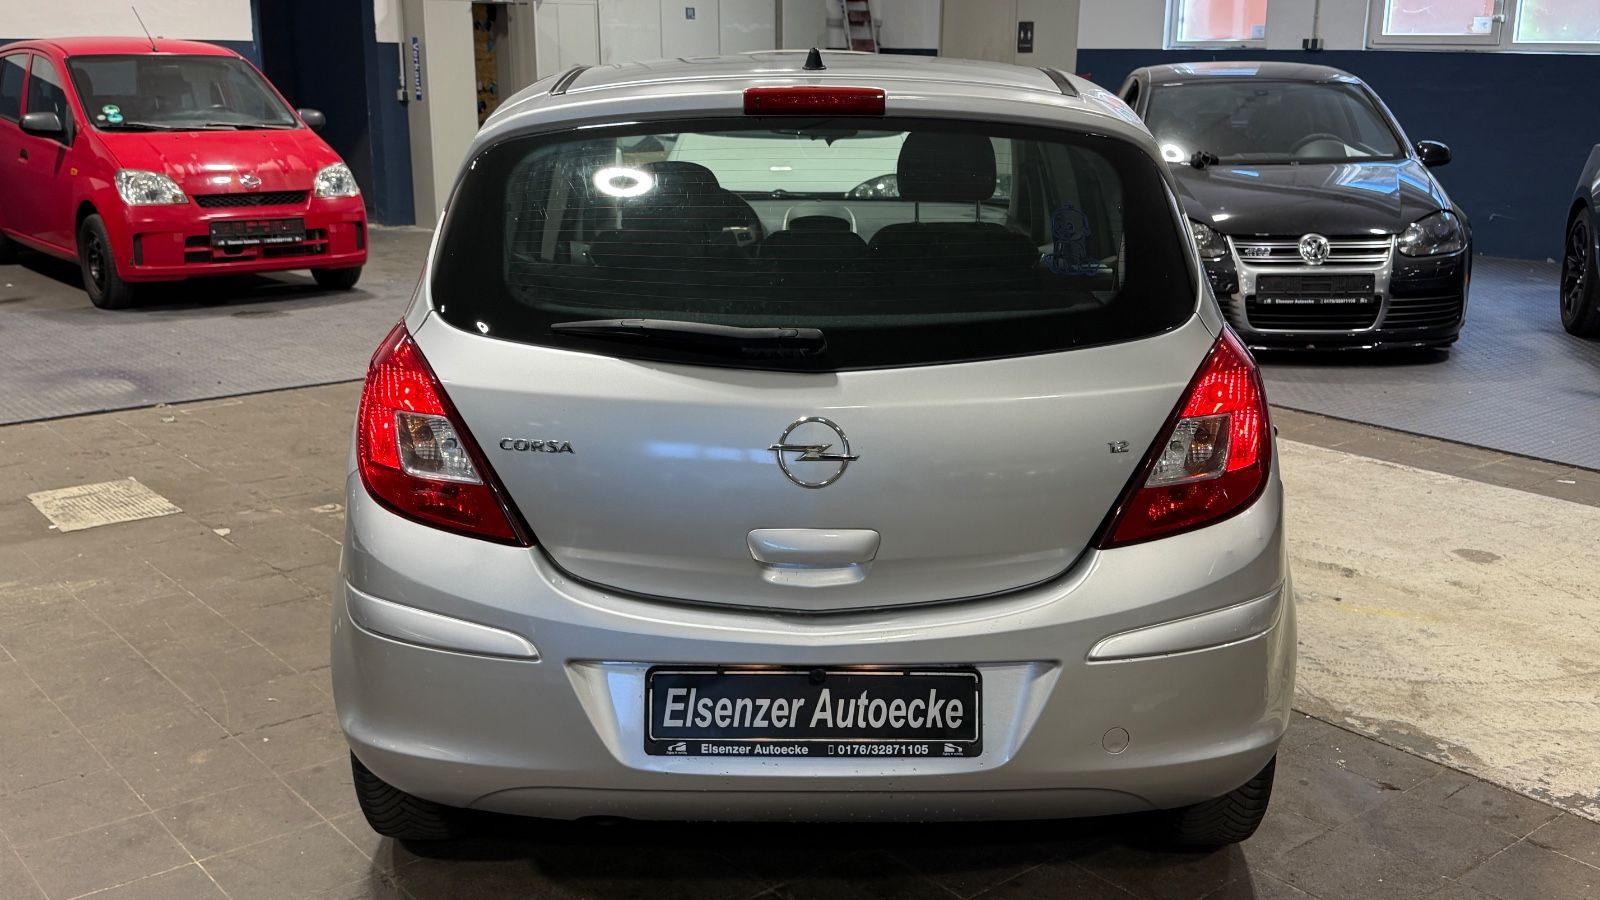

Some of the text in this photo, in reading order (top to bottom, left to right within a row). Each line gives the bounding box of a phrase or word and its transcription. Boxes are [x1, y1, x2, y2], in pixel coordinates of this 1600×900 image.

[499, 437, 575, 454] CORSA
[662, 687, 964, 729] Elsenzer Autoecke
[701, 743, 929, 755] Elsenzer Autoecke 0176/32871105
